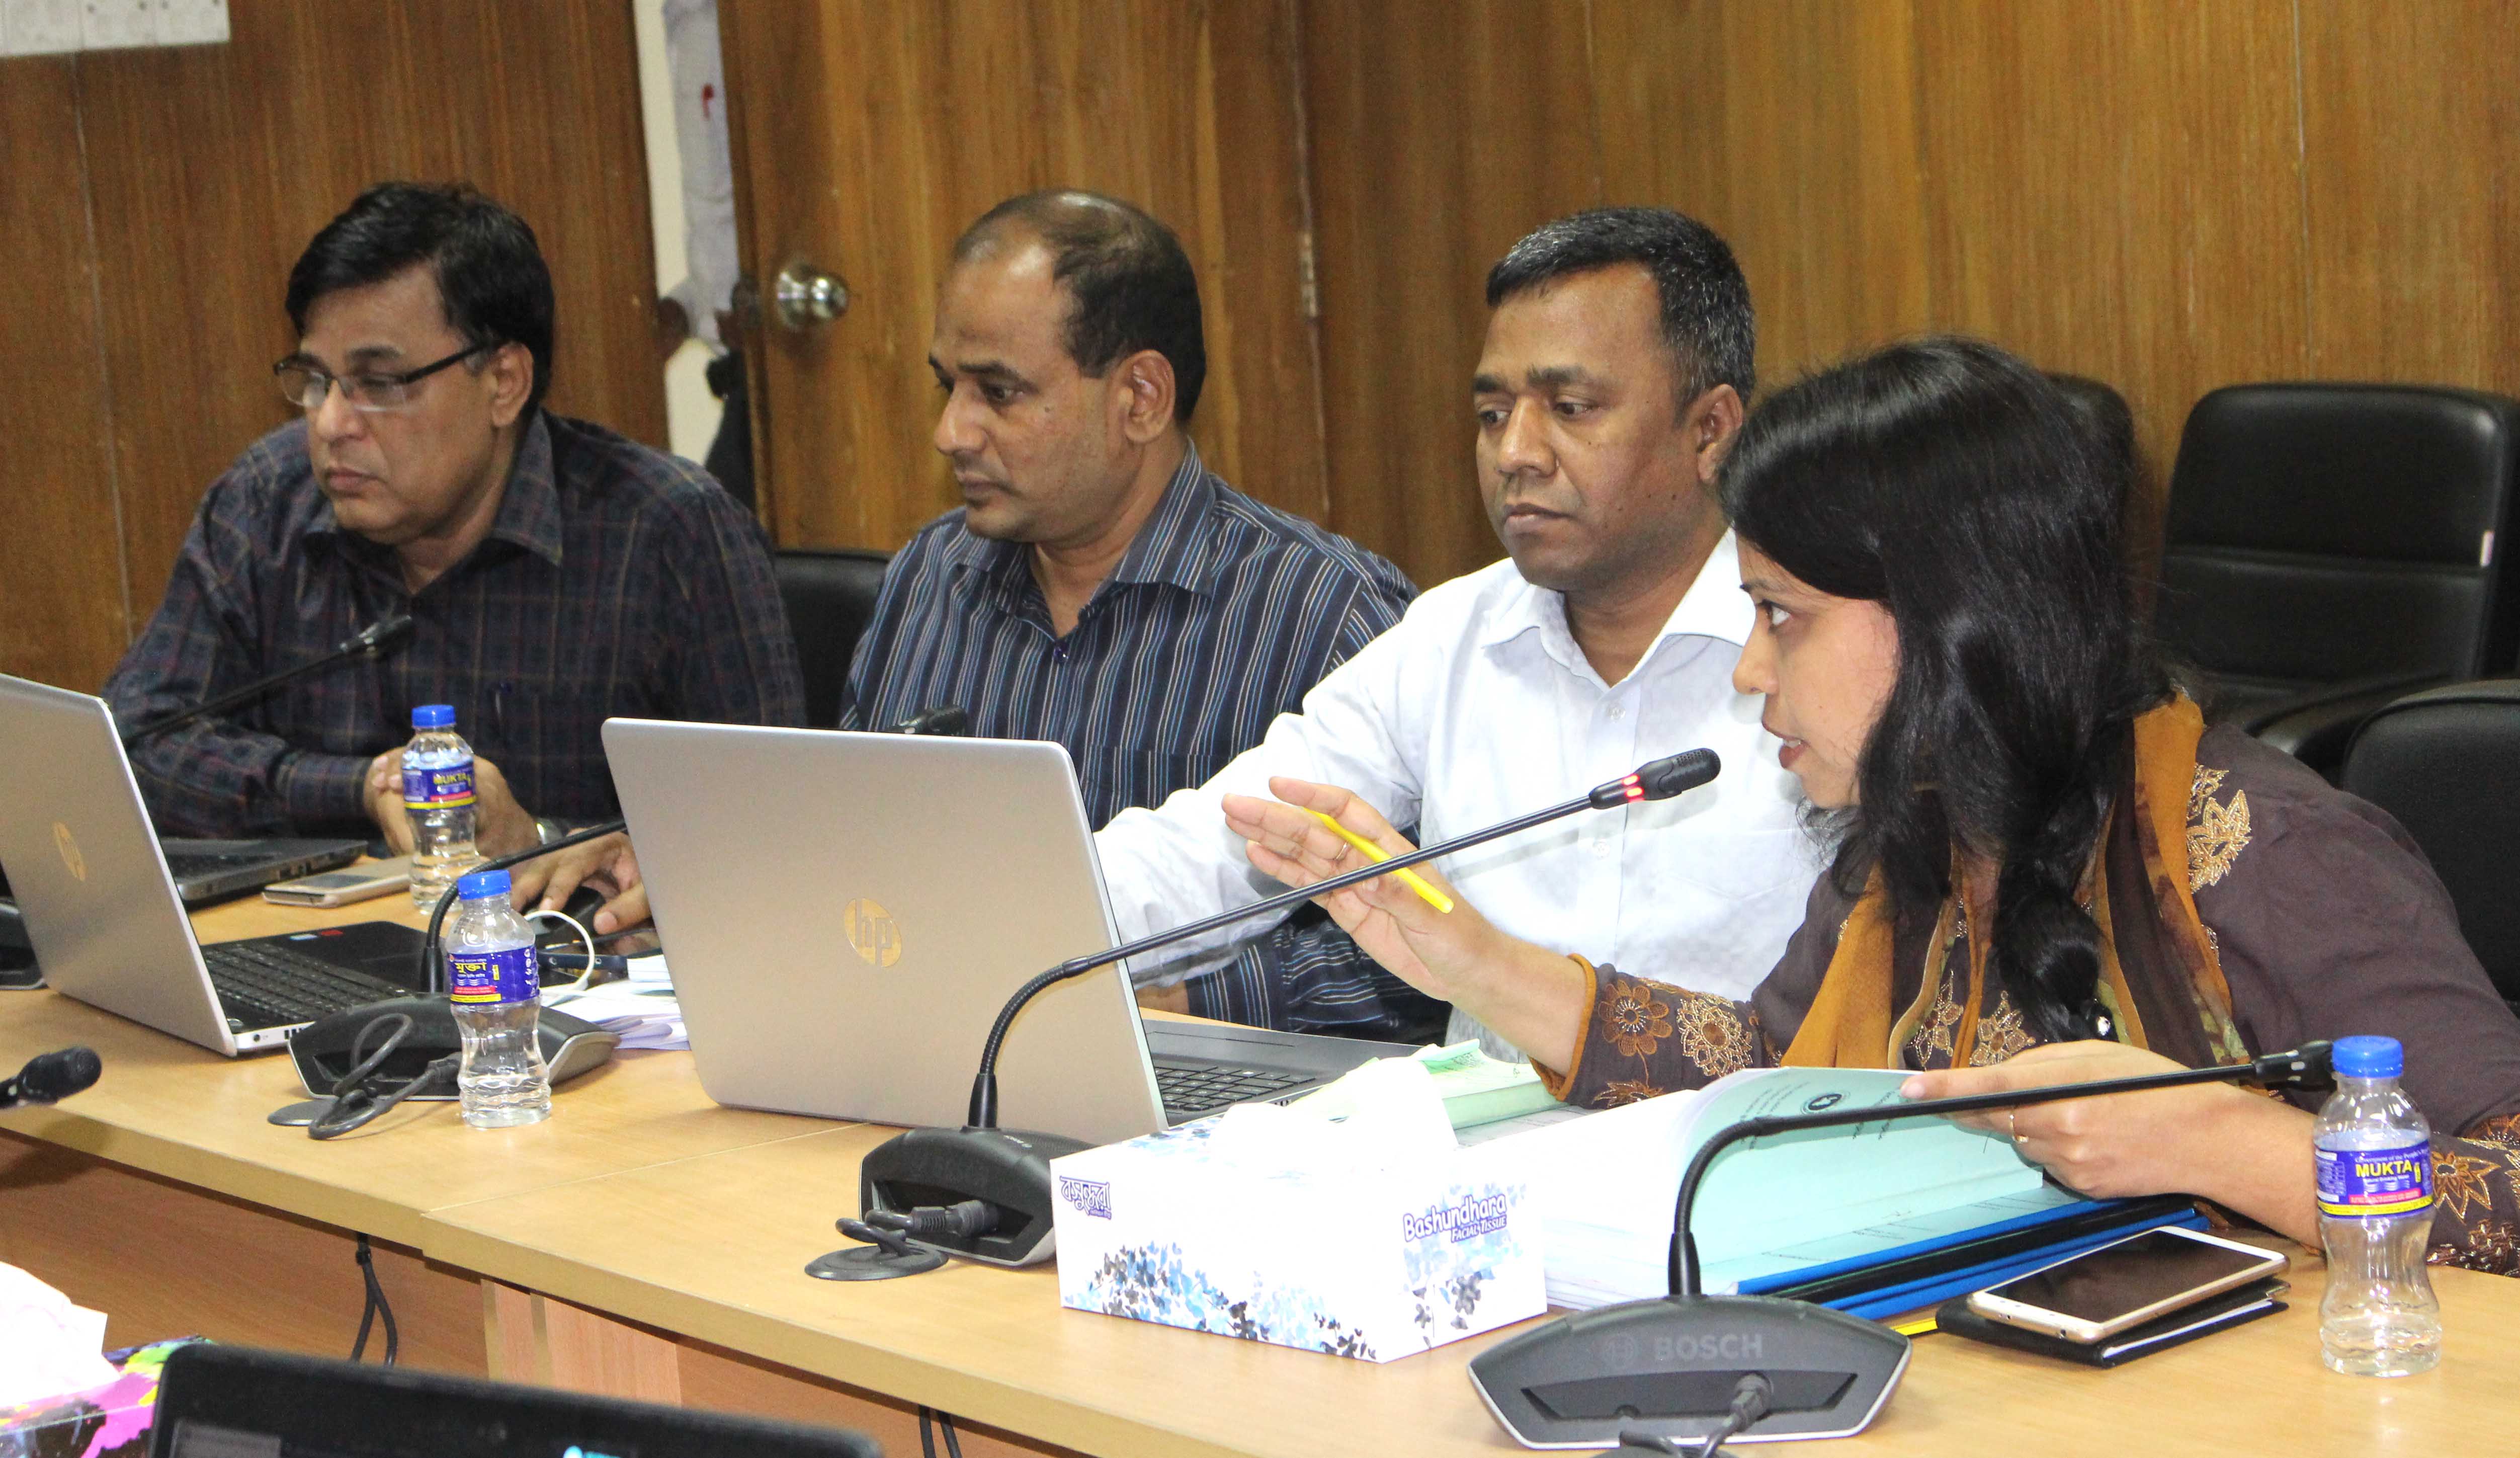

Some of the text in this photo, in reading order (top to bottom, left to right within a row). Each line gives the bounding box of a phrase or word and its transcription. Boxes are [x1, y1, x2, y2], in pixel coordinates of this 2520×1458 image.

[851, 898, 896, 966] hp
[455, 962, 487, 974] মুক্তা
[2355, 1160, 2412, 1177] MUKTA
[1059, 1175, 1111, 1216] বসুন্ধরা
[1403, 1193, 1507, 1242] Bashundhara
[1654, 1333, 1762, 1361] BOSCH
